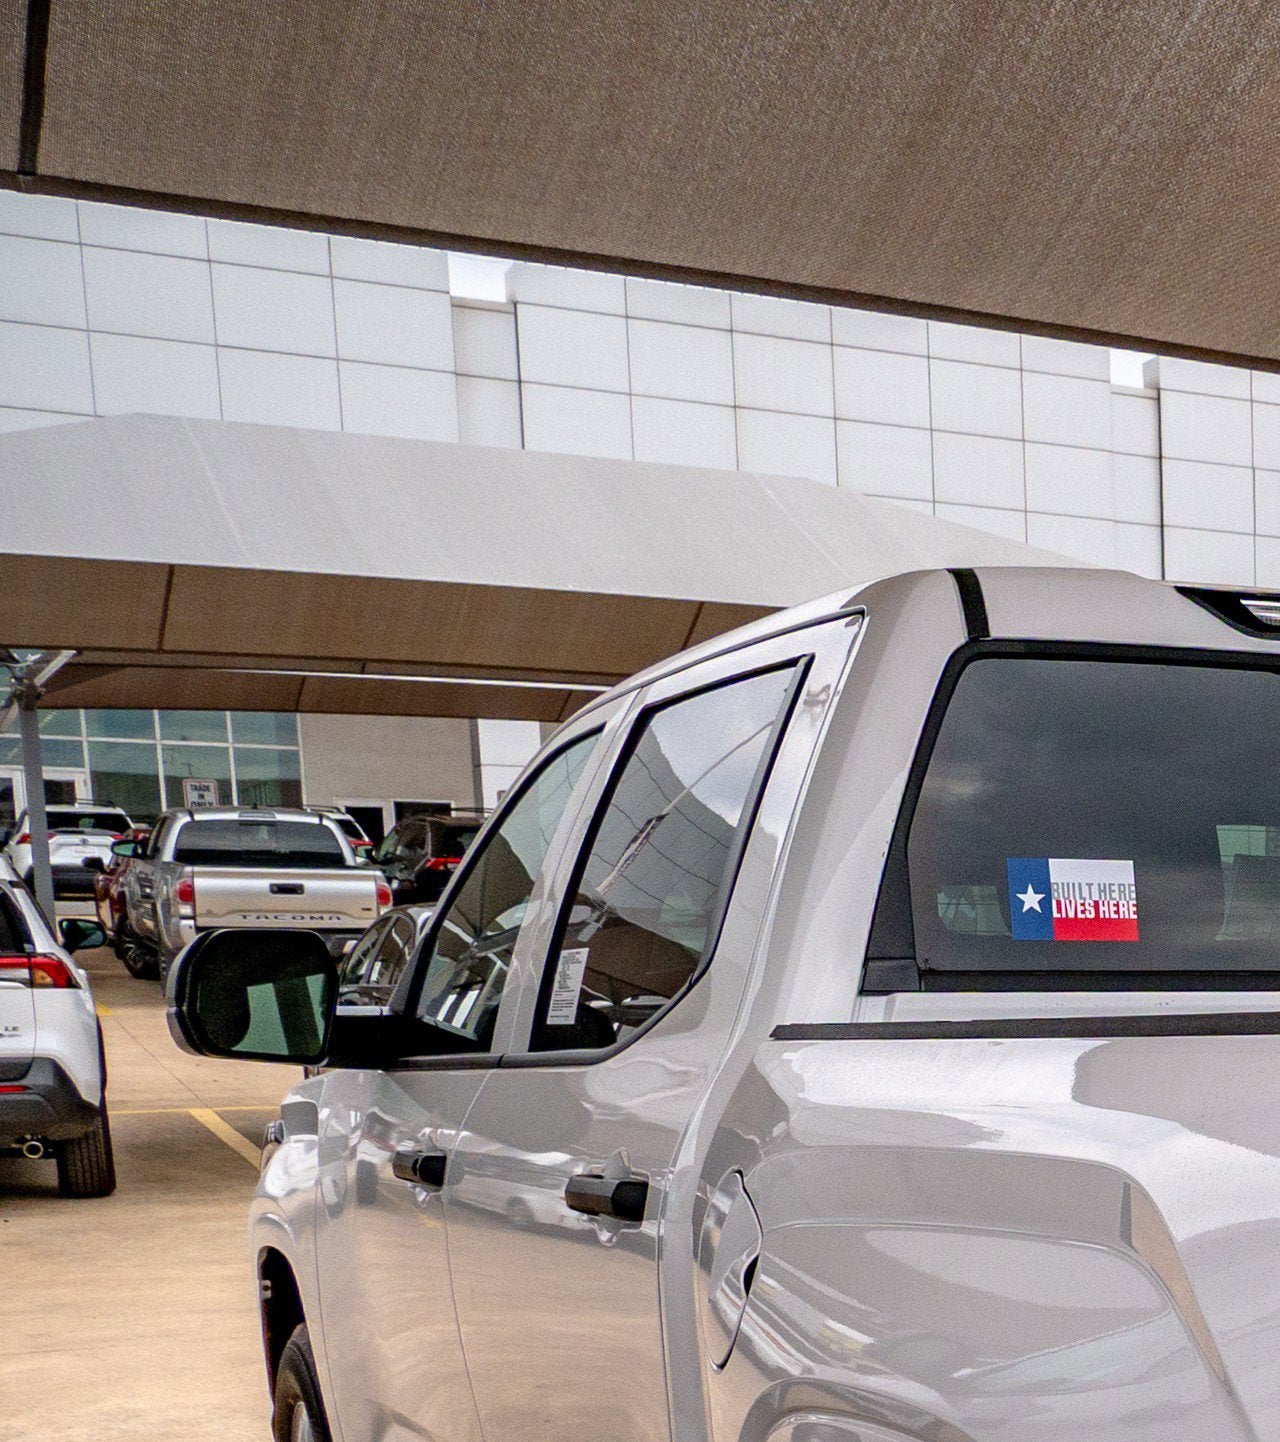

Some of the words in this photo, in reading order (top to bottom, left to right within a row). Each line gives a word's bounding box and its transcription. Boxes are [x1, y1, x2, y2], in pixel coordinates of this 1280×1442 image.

[1051, 882, 1094, 901] BUILT
[1098, 883, 1136, 901] HERE
[1052, 899, 1095, 919] LIVES
[1098, 899, 1138, 919] HERE
